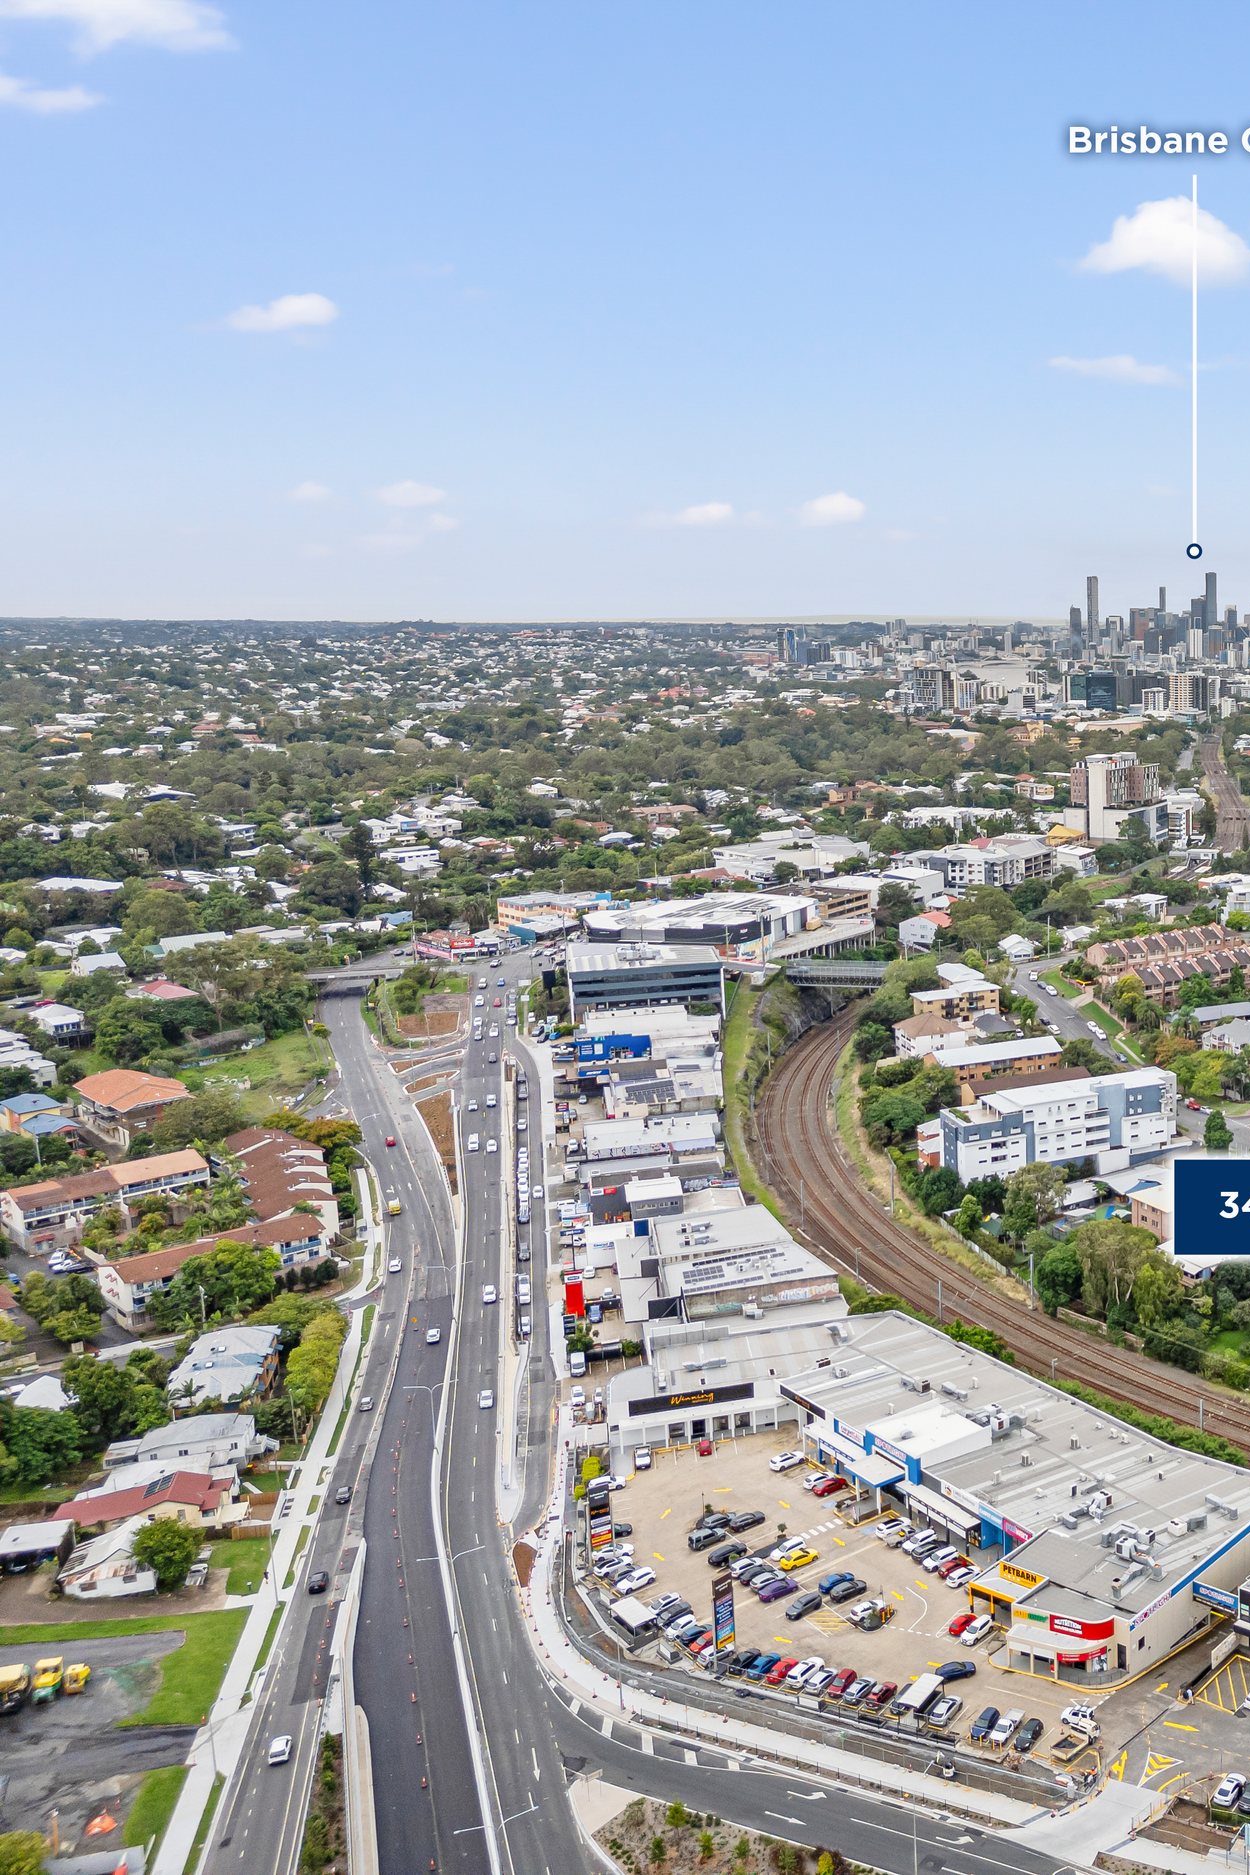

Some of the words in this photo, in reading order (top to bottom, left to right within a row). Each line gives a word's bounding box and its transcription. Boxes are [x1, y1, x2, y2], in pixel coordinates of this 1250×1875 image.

[670, 1392, 714, 1405] Winning
[1003, 1564, 1037, 1584] PETBARN
[1199, 1587, 1235, 1605] SPOTLIGHT
